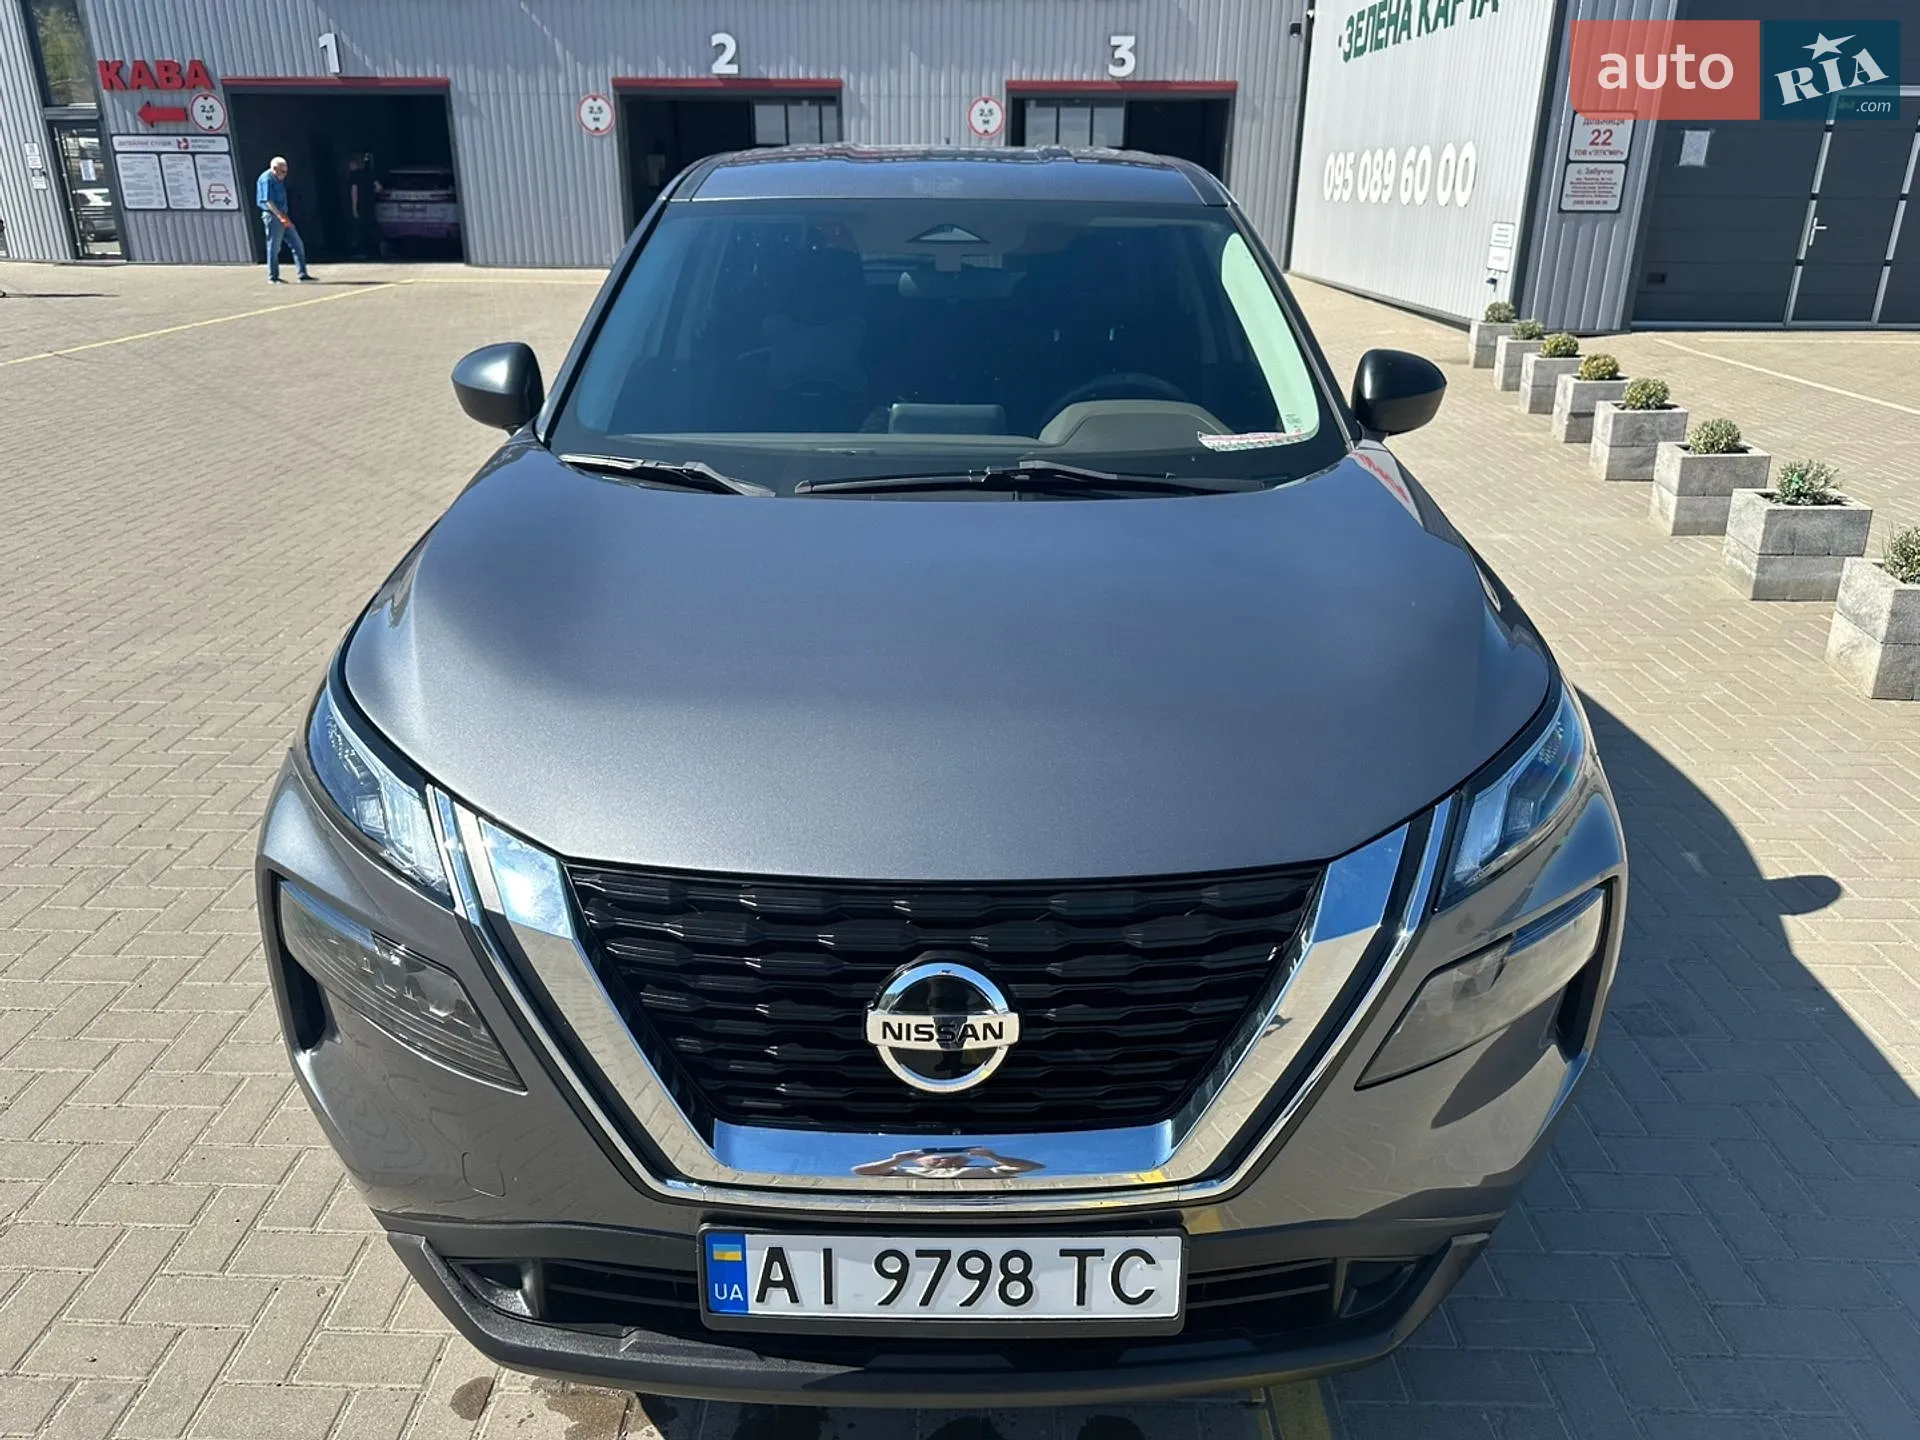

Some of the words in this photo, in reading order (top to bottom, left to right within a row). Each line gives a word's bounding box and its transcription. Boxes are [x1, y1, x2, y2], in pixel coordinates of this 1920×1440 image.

[318, 32, 340, 73] 1
[711, 32, 739, 75] 2
[1108, 35, 1136, 77] 3
[97, 59, 216, 91] КАВА
[1589, 129, 1613, 146] 22
[1323, 151, 1356, 203] 095
[1357, 147, 1397, 204] 089
[1400, 145, 1432, 206] 60
[1436, 141, 1477, 208] 00
[882, 1021, 1004, 1042] NISSAN
[714, 1283, 744, 1302] UA
[754, 1246, 833, 1305] AI
[873, 1248, 1035, 1308] 9798
[1058, 1247, 1157, 1307] TC
